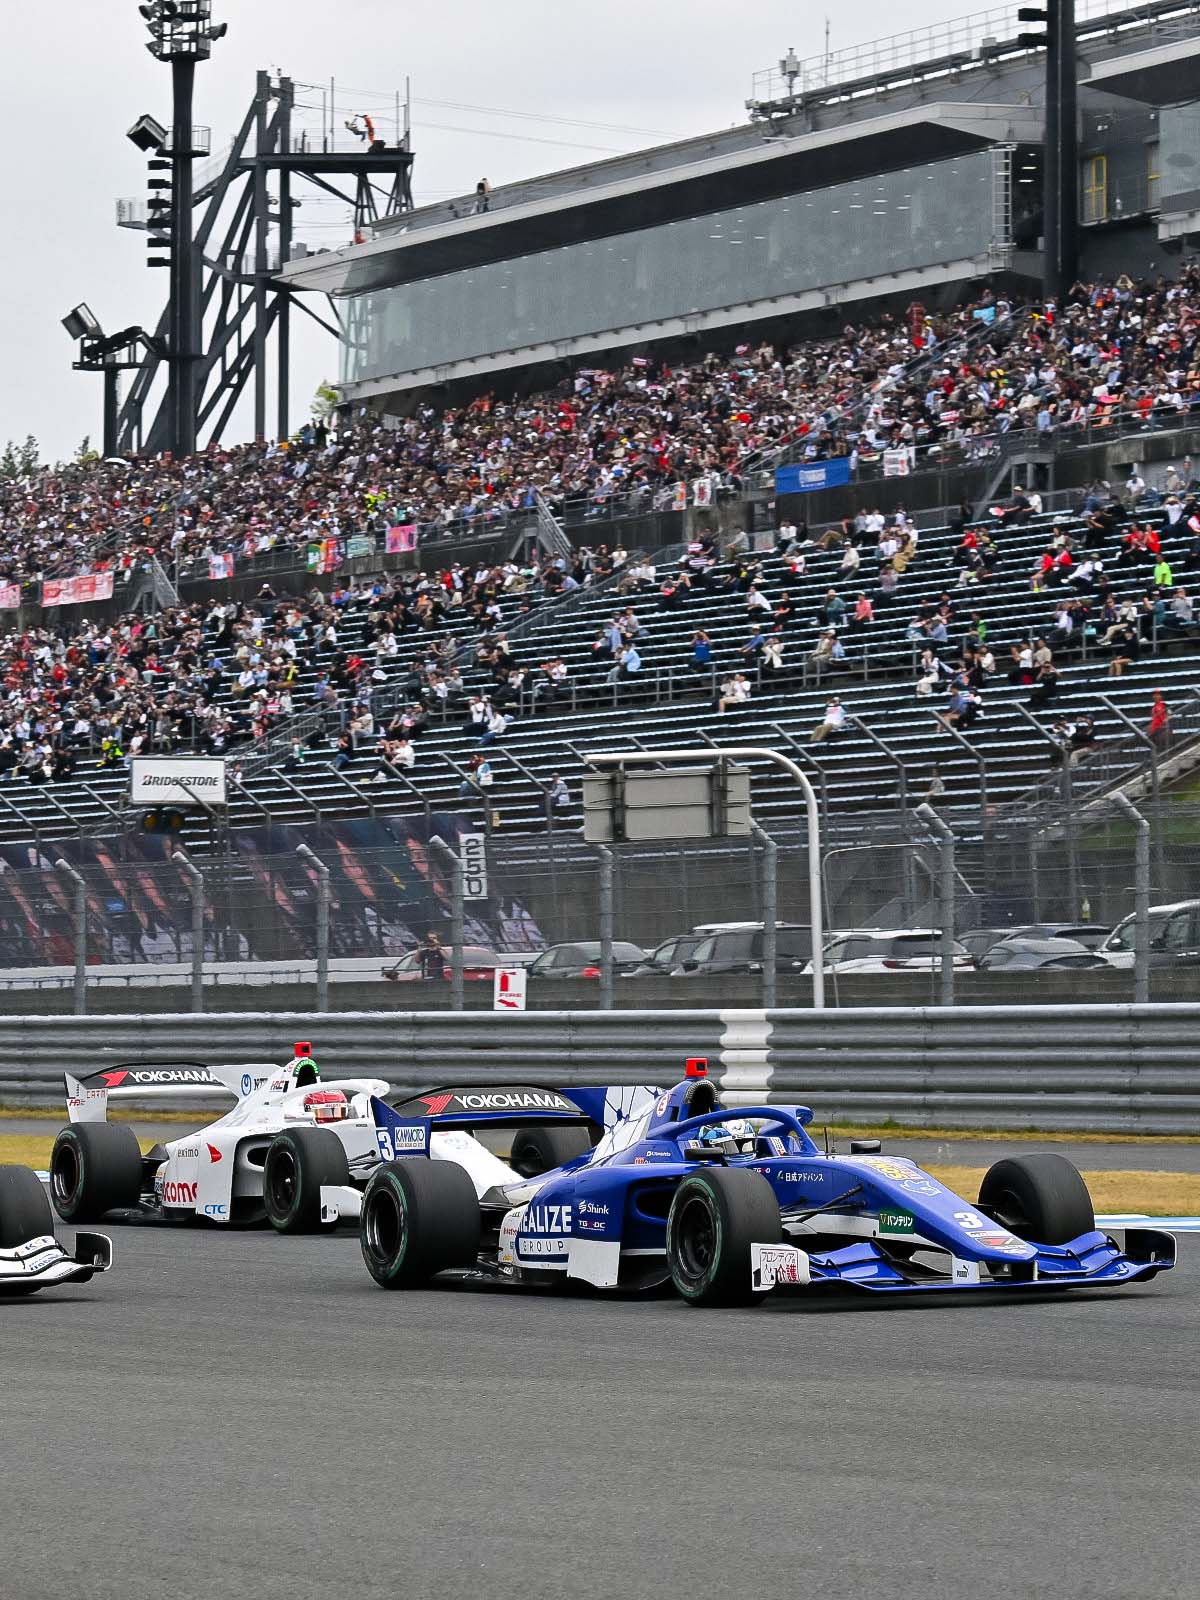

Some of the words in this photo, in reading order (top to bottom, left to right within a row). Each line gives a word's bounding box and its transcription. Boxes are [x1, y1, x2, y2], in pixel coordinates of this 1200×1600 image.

[141, 775, 220, 786] BRIDGESTONE
[465, 838, 482, 894] 250
[454, 1094, 569, 1109] YOKOHAMA
[204, 1205, 227, 1214] CTC
[587, 1203, 609, 1215] Shink
[953, 1212, 983, 1229] 3
[523, 1241, 564, 1252] GROUP
